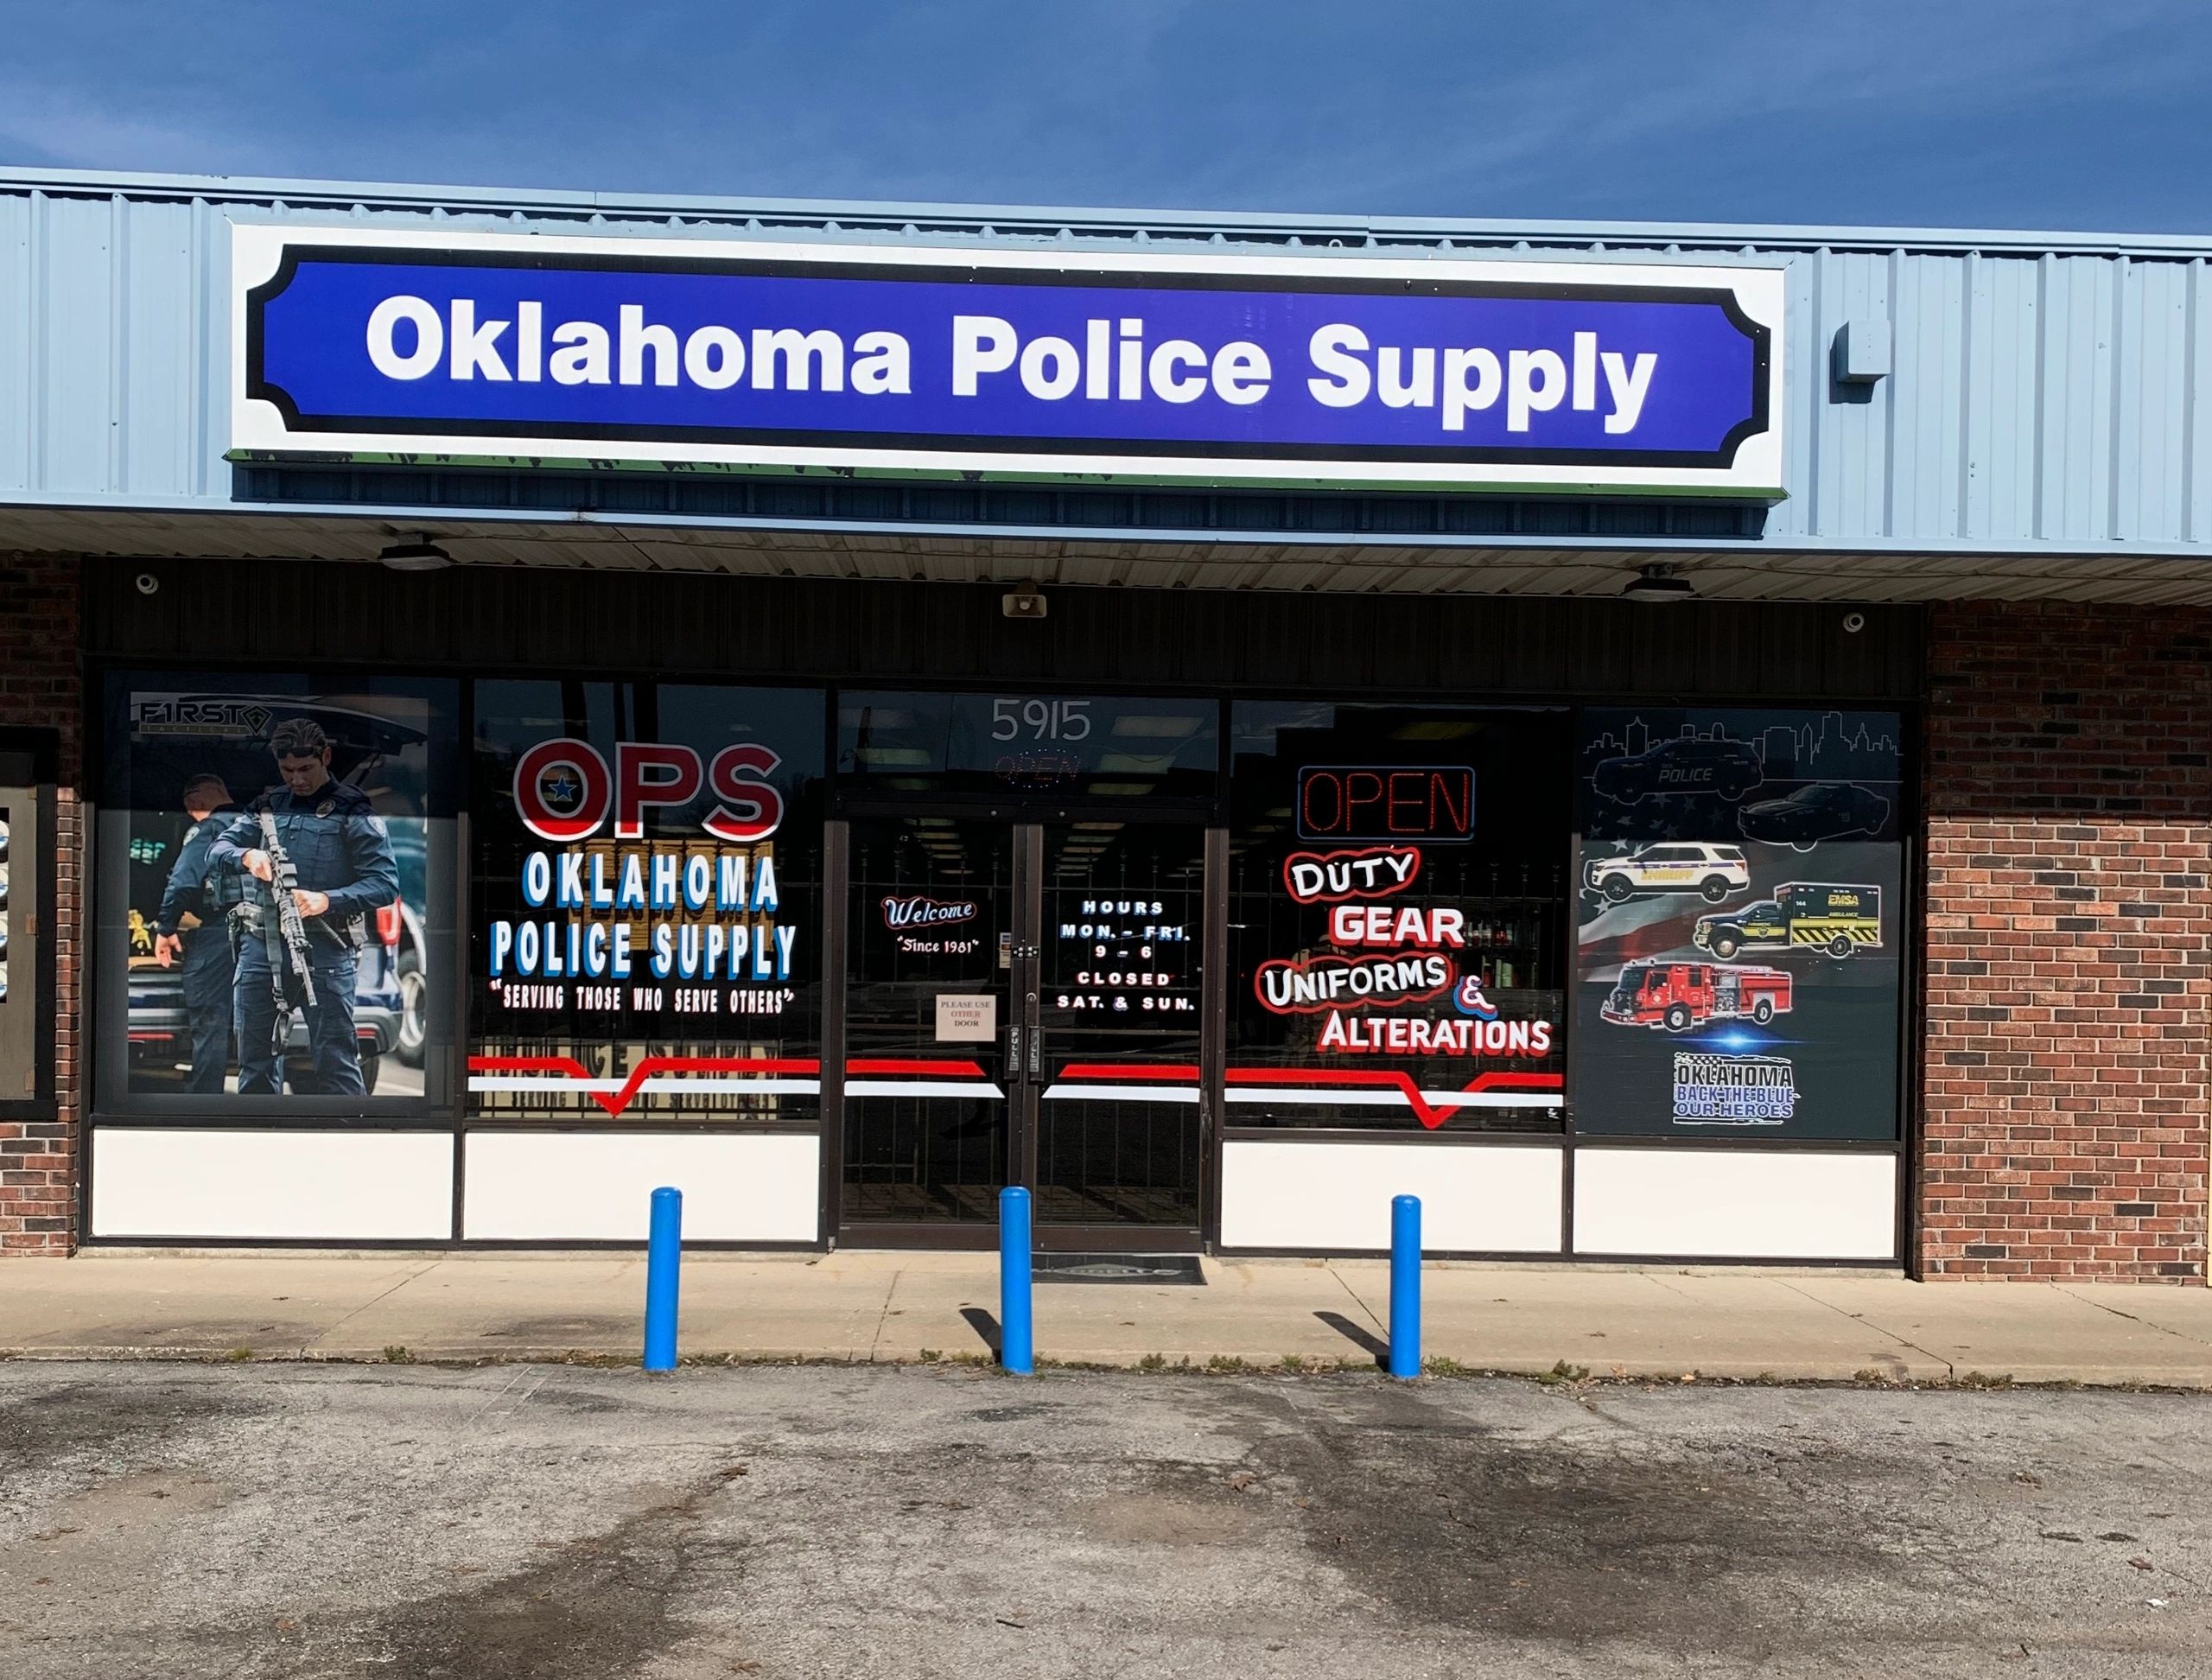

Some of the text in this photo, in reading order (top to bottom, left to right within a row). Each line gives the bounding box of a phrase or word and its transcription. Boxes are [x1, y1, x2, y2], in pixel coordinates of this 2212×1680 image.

[366, 295, 1658, 435] Oklahoma Police Supply
[140, 703, 247, 724] F1RST
[992, 699, 1090, 741] 5915
[146, 725, 242, 734] TACTICAL
[995, 755, 1080, 780] OPEN
[1658, 768, 1713, 783] POLICE
[513, 738, 785, 842] OPS
[1305, 773, 1468, 831] OPEN
[523, 852, 778, 912] OKLAHOMA
[1291, 854, 1414, 897] DUTY
[885, 898, 972, 926] Welcome
[1082, 900, 1163, 915] HOURS
[1827, 894, 1859, 907] EMSA
[1060, 925, 1116, 939] MON.
[1144, 926, 1191, 940] FRI.
[1329, 906, 1465, 947] GEAR
[490, 920, 796, 980] POLICE SUPPLY
[897, 935, 939, 952] "Since
[1095, 945, 1107, 958] 9
[1141, 946, 1152, 958] 6
[1077, 971, 1170, 986] CLOSED
[1265, 956, 1498, 1020] UNIFORMS &
[489, 978, 795, 1014] "SERVING THOSE WHO SERVE OTHERS"
[1057, 996, 1195, 1011] SAT. & SUN.
[1317, 1009, 1552, 1058] ALTERATIONS
[1677, 1065, 1792, 1086] OKLAHOMA
[1677, 1086, 1794, 1104] BACK THE BLUE
[1676, 1103, 1793, 1117] OUR HEROES
